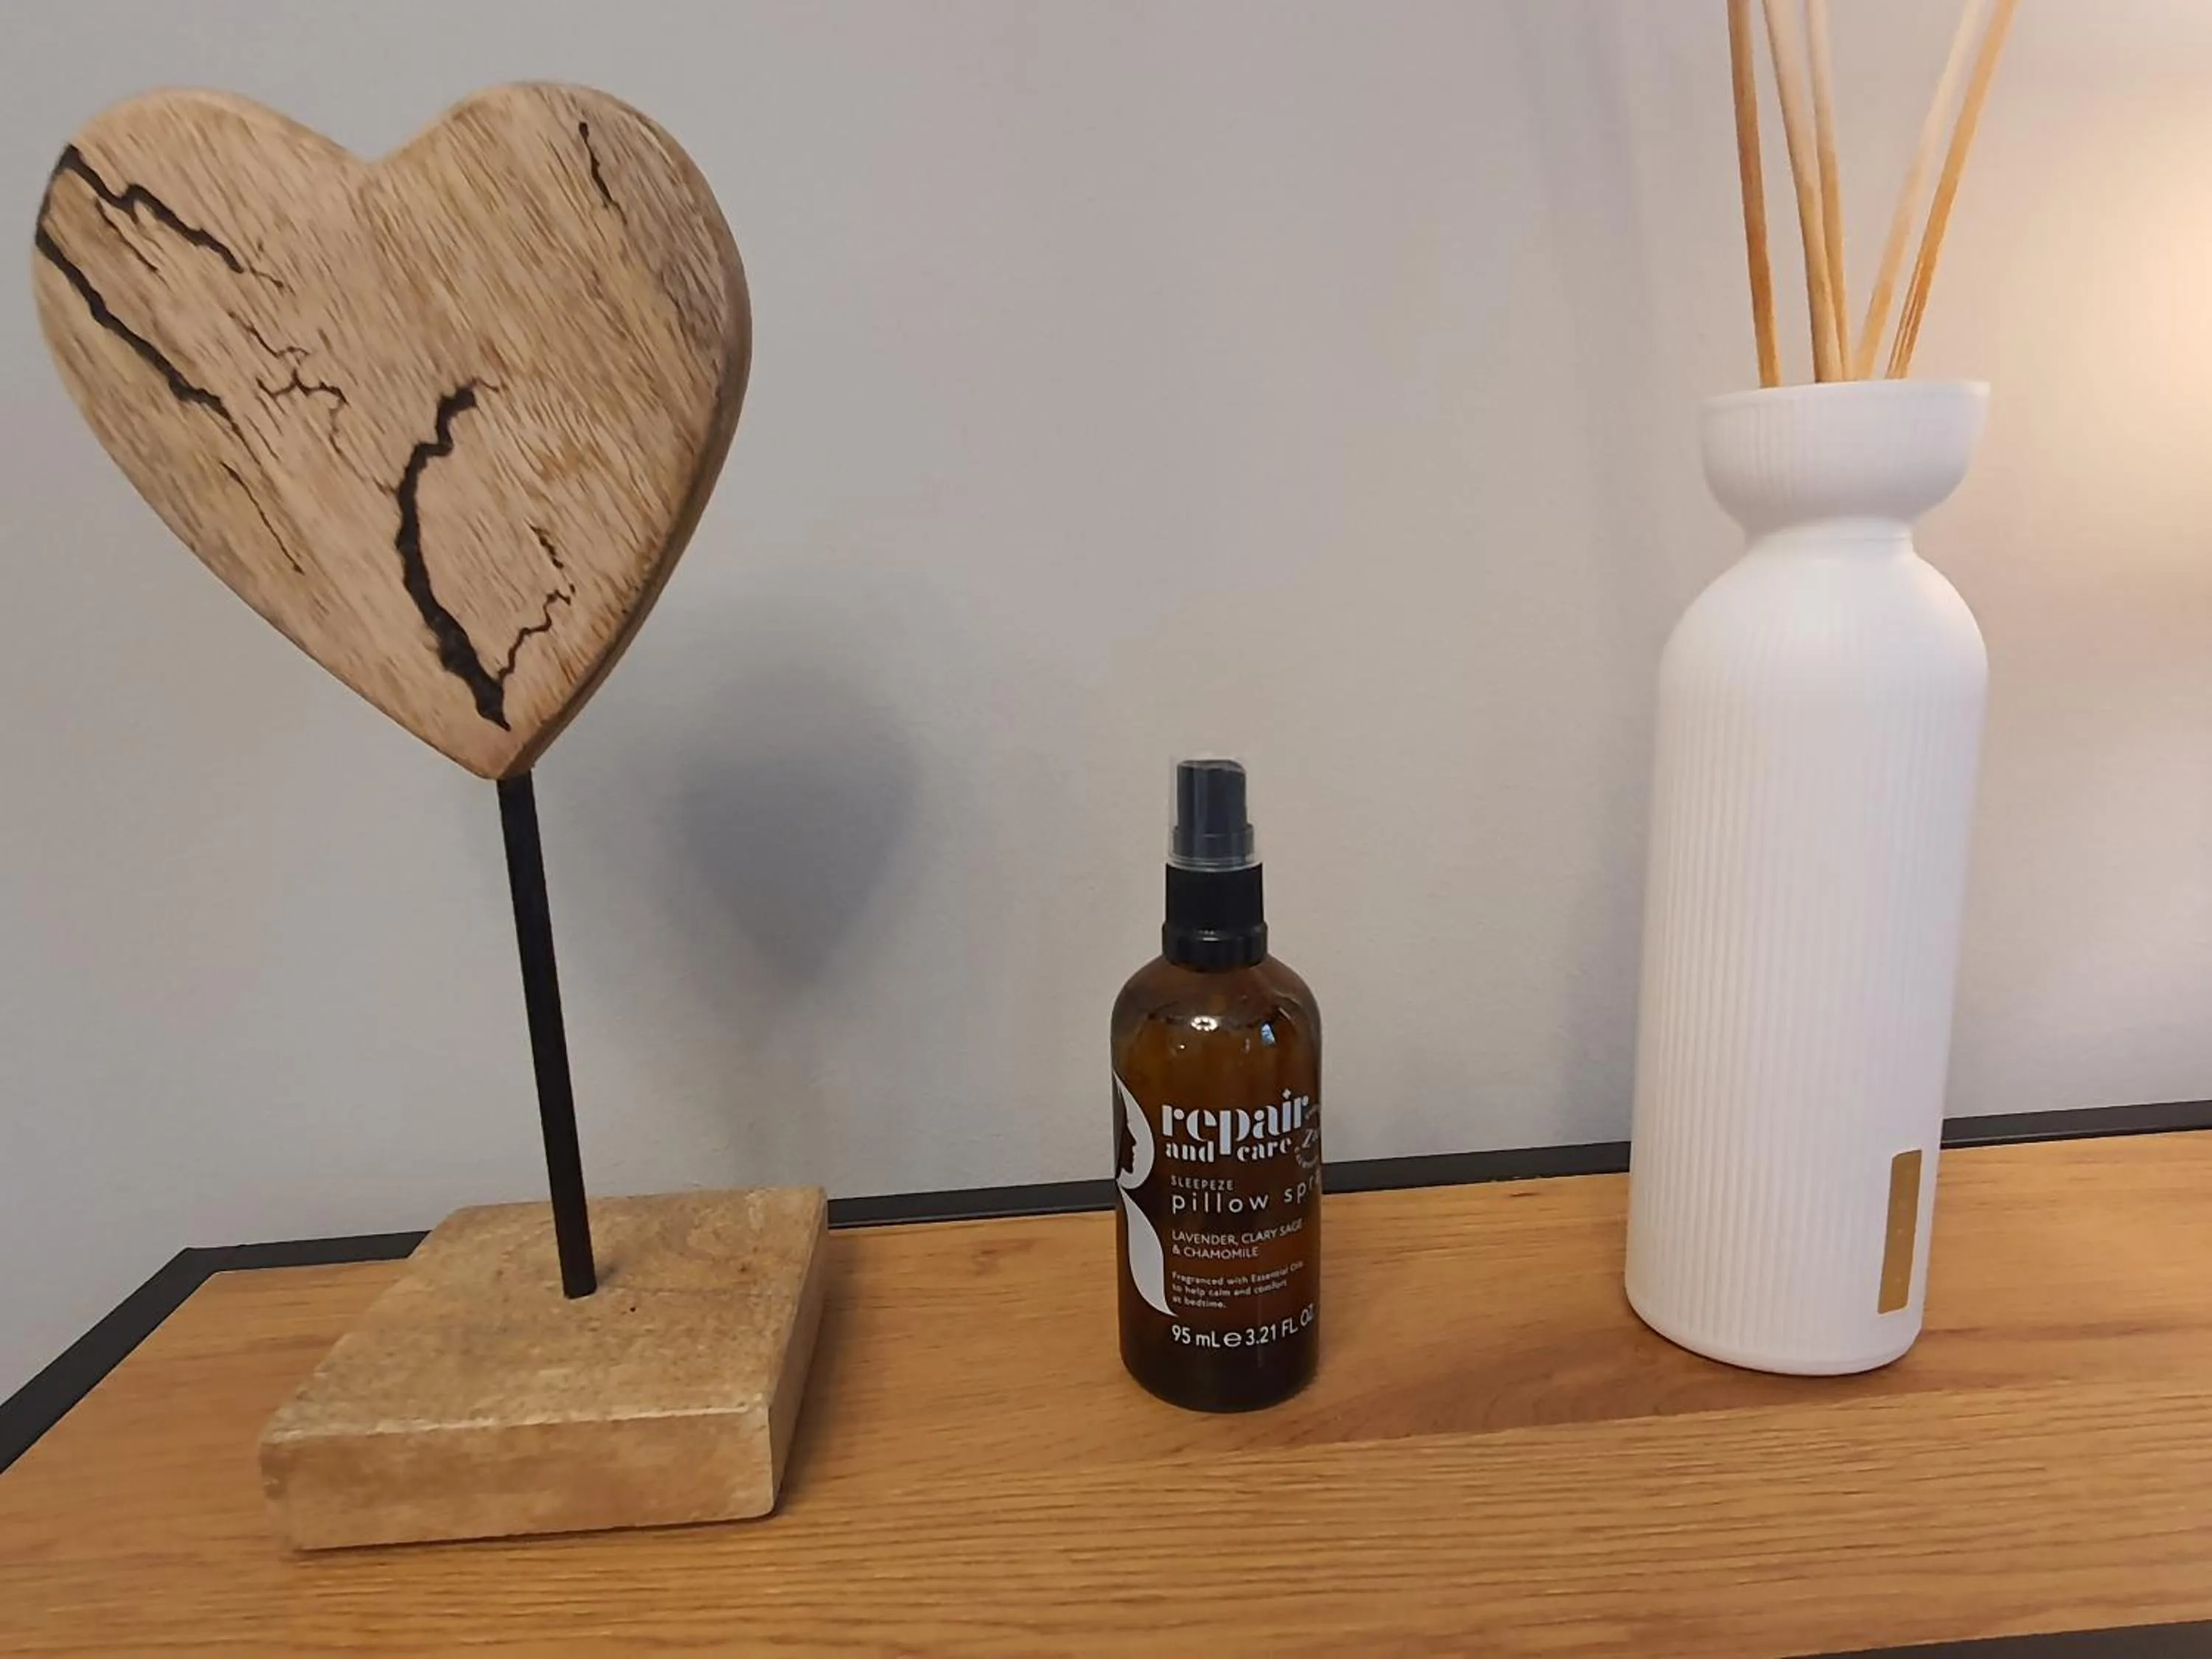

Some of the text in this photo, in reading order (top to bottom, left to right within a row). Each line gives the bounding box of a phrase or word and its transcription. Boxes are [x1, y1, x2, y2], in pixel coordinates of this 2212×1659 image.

[1162, 1088, 1309, 1155] repair
[1166, 1138, 1291, 1163] and care
[1171, 1175, 1234, 1191] SLEEPEZE
[1172, 1192, 1269, 1214] pillow
[1172, 1217, 1303, 1246] LAVENDER, CLARY SAGE
[1172, 1245, 1260, 1260] & CHAMOMILE
[1172, 1271, 1224, 1285] Fragranced
[1227, 1275, 1248, 1285] with
[1172, 1279, 1287, 1298] to help calm and comfort
[1172, 1324, 1191, 1344] 95
[1195, 1330, 1220, 1348] mL
[1245, 1324, 1276, 1346] 3.21
[1281, 1317, 1298, 1338] FL
